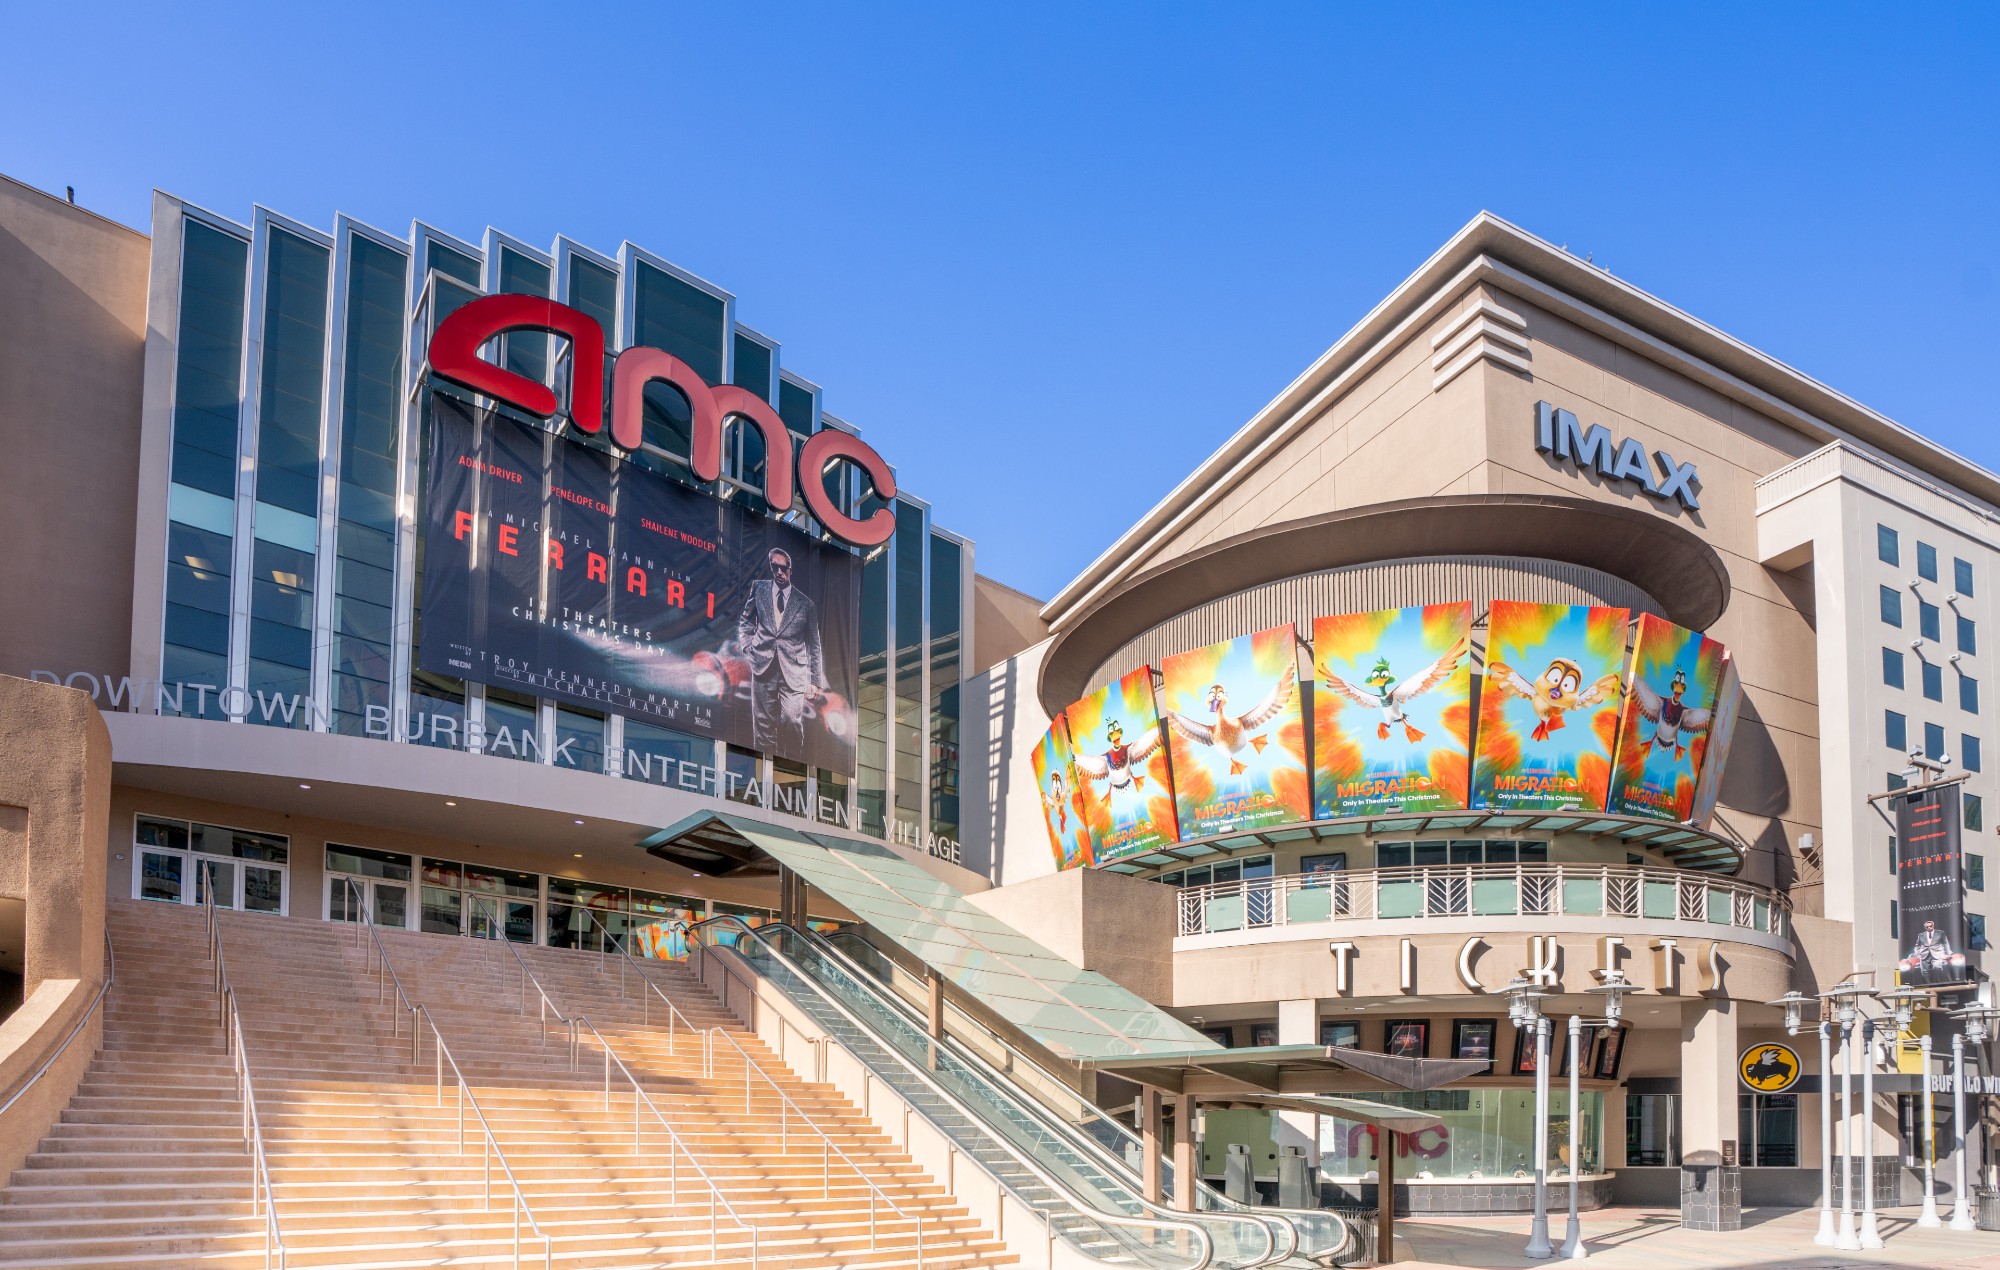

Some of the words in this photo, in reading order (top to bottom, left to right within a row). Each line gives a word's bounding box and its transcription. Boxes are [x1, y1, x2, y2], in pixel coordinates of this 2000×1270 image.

[426, 293, 897, 547] amc
[458, 455, 486, 472] ADAM
[489, 464, 523, 484] DRIVER
[1534, 400, 1700, 511] IMAX
[550, 486, 593, 509] PENÉLOPE
[488, 510, 493, 518] A
[506, 513, 591, 549] MICHAEL
[609, 548, 654, 570] MANN
[664, 567, 691, 583] FILM
[641, 518, 678, 539] SHAILENE
[680, 532, 716, 553] WOODLEY
[455, 510, 714, 618] FERRARI
[512, 606, 620, 645] CHRISTMAS
[635, 641, 665, 656] DAY
[529, 597, 547, 611] IN
[564, 607, 651, 641] THEATERS
[481, 651, 529, 671] TROY
[548, 667, 632, 697] KENNEDY
[649, 693, 712, 718] MARTIN
[528, 673, 613, 701] MICHAEL
[629, 698, 675, 718] MANN
[365, 705, 576, 765] BURBANK
[607, 745, 868, 831] ENTERTAINMENT
[883, 815, 961, 864] VILLAGE
[1337, 775, 1446, 798] MIGRATION
[1408, 794, 1440, 802] Christmas
[1494, 775, 1590, 793] MIGRATION
[1623, 784, 1683, 812] MIGRATION
[1195, 792, 1288, 820] MIGRATION
[1220, 817, 1243, 825] Theaters
[1256, 809, 1284, 819] Christmas
[1899, 853, 1960, 868] FERRARI
[1330, 935, 1721, 993] TICKETS
[1931, 1074, 1981, 1093] BUFLO
[1983, 1075, 2000, 1093] WI
[1424, 1100, 1429, 1108] 6
[1475, 1100, 1481, 1108] 5
